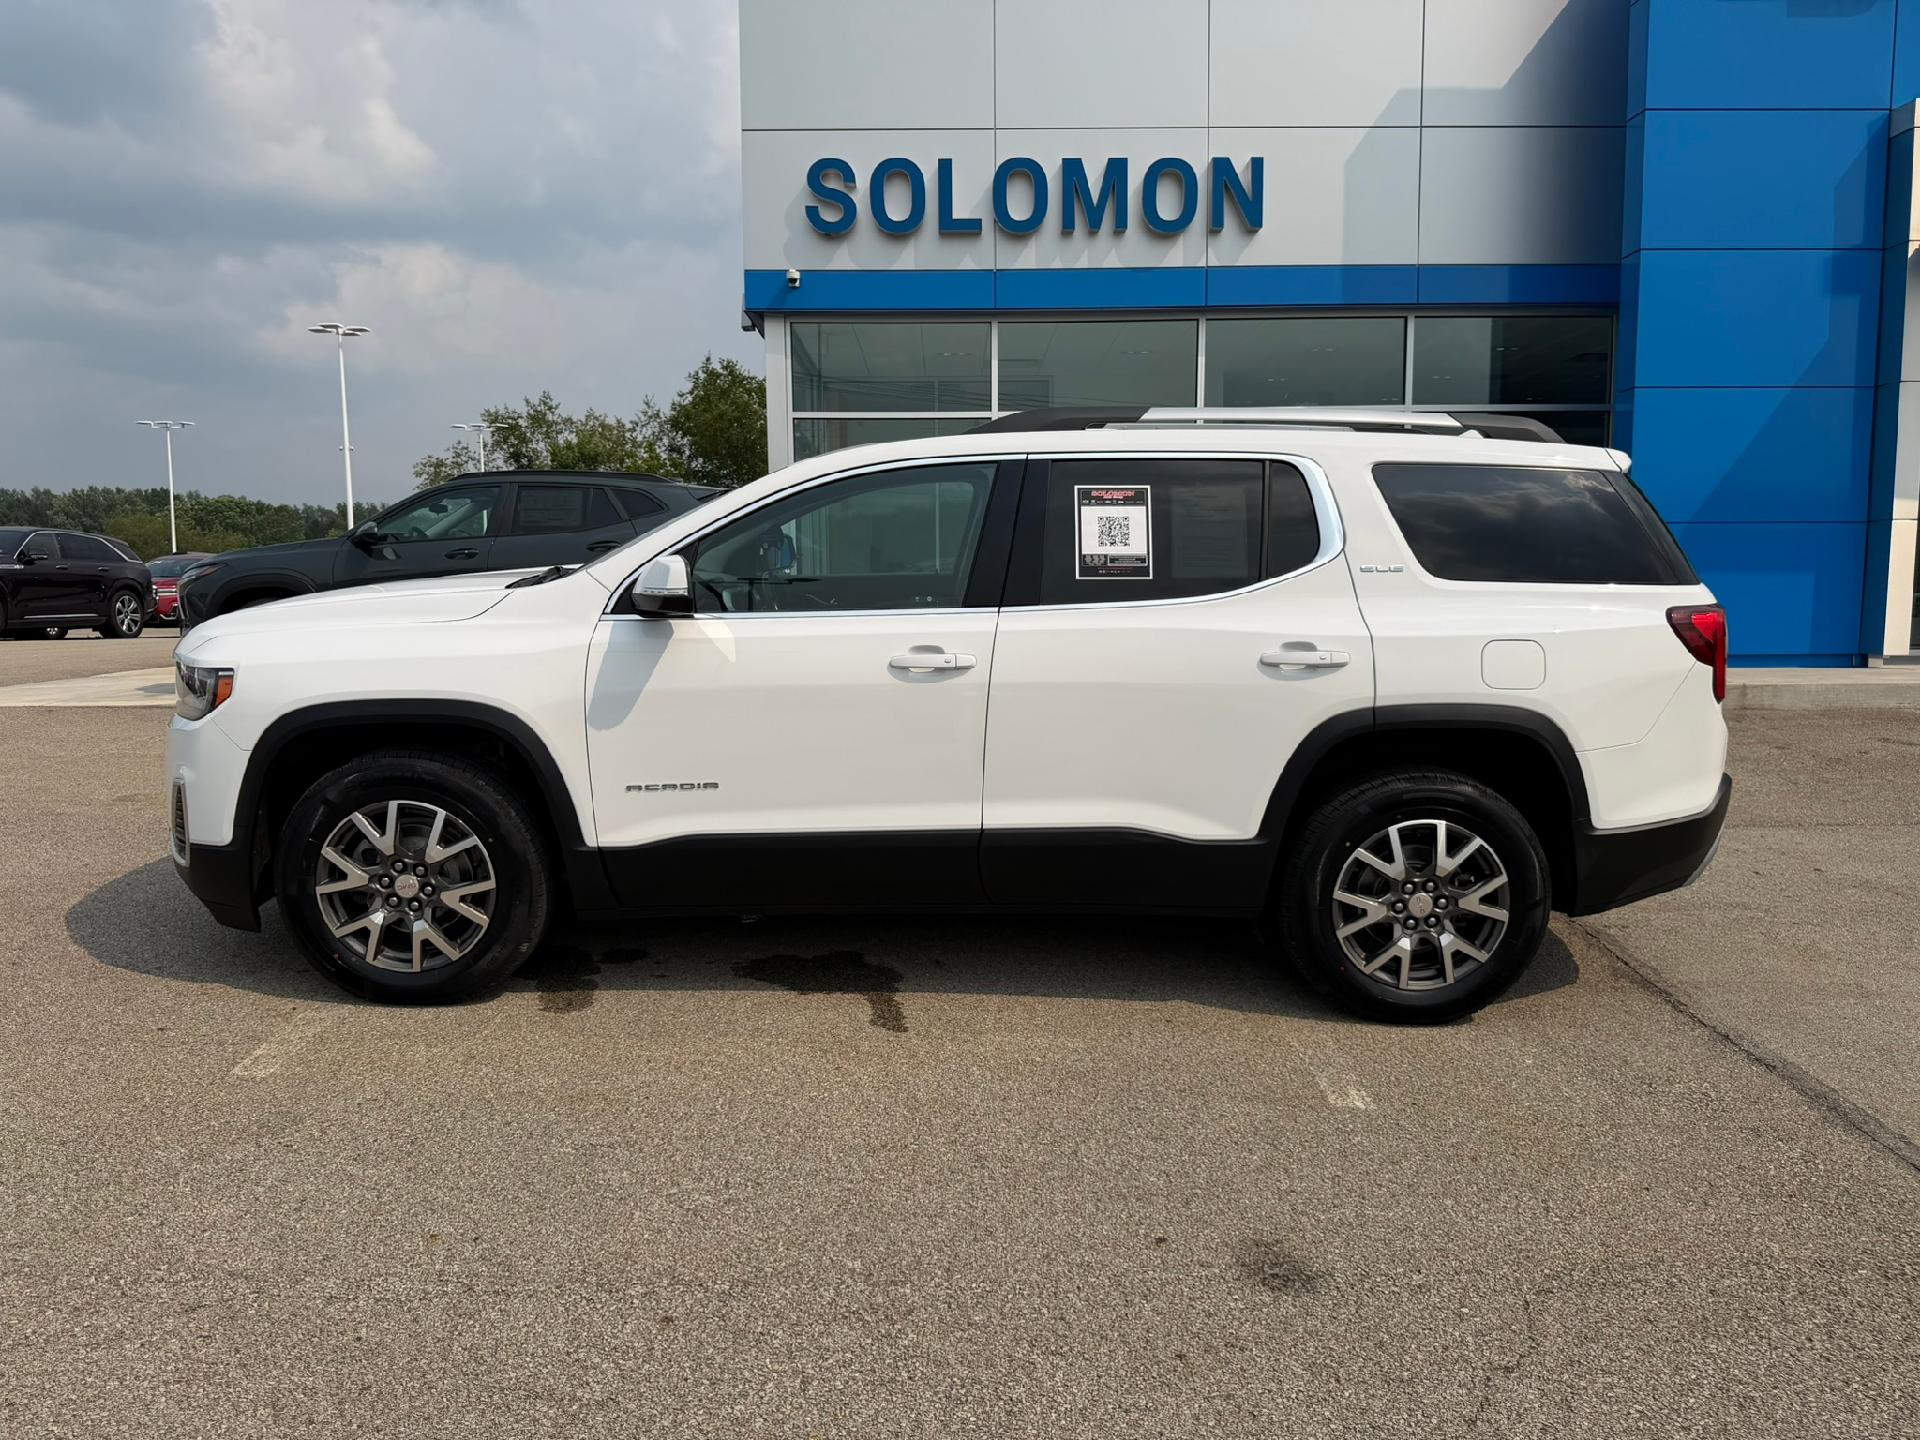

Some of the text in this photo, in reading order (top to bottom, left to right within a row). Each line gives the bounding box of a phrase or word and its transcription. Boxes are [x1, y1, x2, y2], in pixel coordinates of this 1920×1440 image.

[804, 156, 1265, 236] SOLOMON
[1359, 564, 1404, 573] SLE
[625, 782, 720, 792] ACADIA
